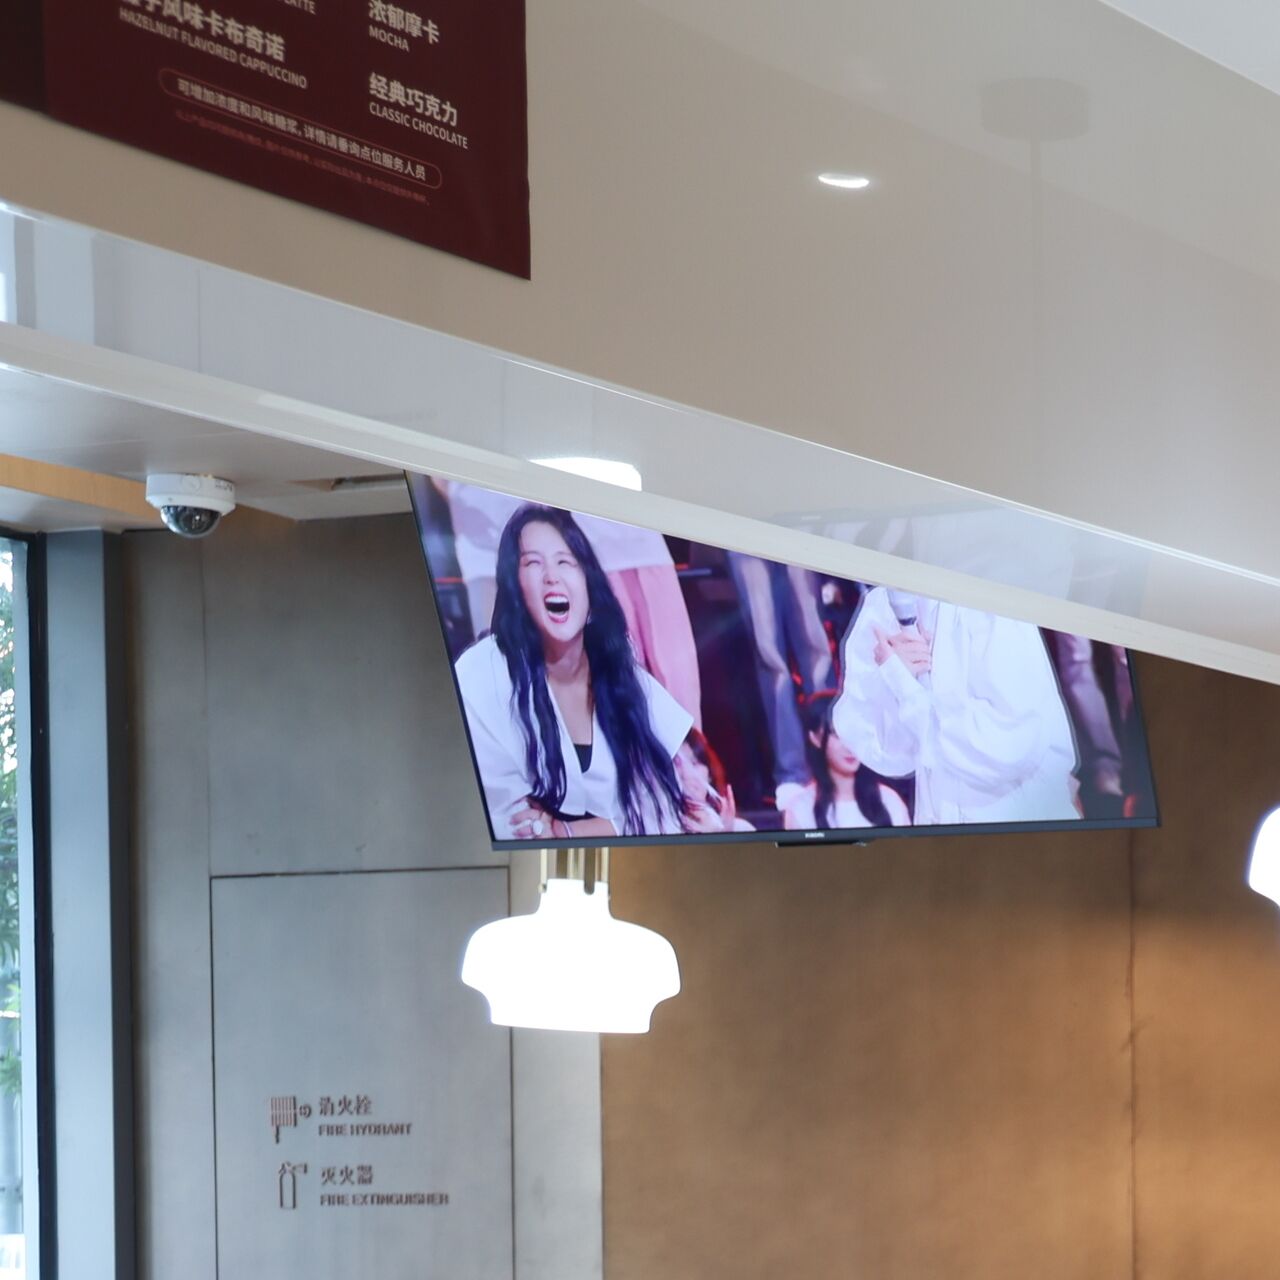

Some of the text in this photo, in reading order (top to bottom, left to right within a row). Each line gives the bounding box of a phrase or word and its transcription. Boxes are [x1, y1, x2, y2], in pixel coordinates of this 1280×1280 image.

[119, 7, 308, 89] HAZELNUT FLAVORED CAPPUCCINO
[369, 25, 410, 52] MOCHA
[369, 72, 458, 126] 经典巧克力
[369, 102, 469, 149] CLASSIC CHOCOLATE
[319, 1094, 372, 1116] 消火栓
[319, 1122, 413, 1136] FIRE HYDRANT
[321, 1165, 373, 1186] 灭火器
[320, 1193, 449, 1206] FIRE EXTINGUISHER
